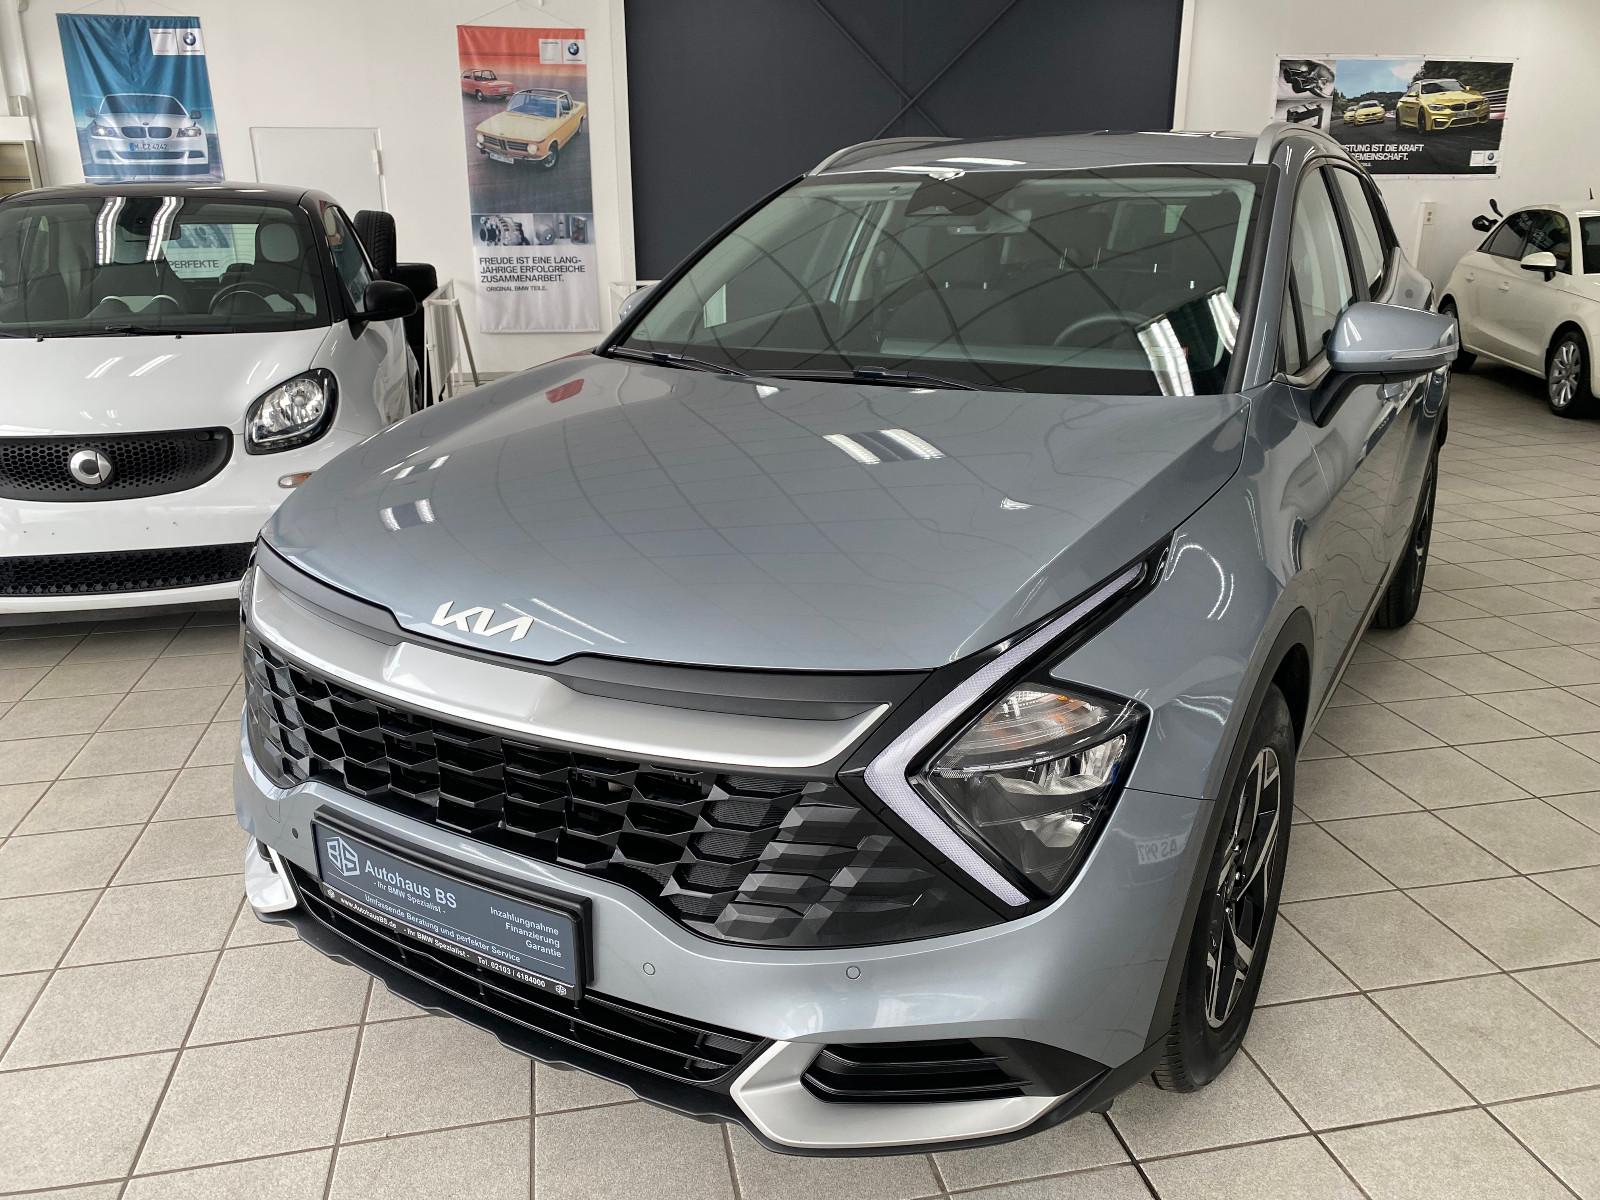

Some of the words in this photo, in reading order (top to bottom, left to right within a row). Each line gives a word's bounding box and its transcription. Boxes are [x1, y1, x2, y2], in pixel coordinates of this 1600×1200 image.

[1344, 144, 1370, 152] STUNG
[1371, 144, 1384, 152] IST
[1385, 144, 1398, 152] DIE
[1398, 144, 1424, 152] KRAFT
[168, 259, 220, 269] PERFEKTE
[479, 256, 514, 265] FREUDE
[516, 256, 530, 265] IST
[532, 256, 551, 265] EINE
[553, 255, 582, 264] LANG-
[520, 264, 586, 274] ERFOLGREICHE
[480, 274, 565, 283] ZUSAMMENARBEIT.
[431, 600, 535, 642] KIA
[364, 860, 431, 899] Autohaus
[434, 887, 457, 909] BS
[377, 881, 387, 891] Ihr
[387, 885, 406, 899] BMW
[407, 894, 442, 913] Spezialist
[340, 897, 397, 929] www.AutohausBS.de
[490, 906, 559, 936] Inzahlungnahme
[364, 893, 405, 918] Umfassende
[406, 912, 439, 933] Beratung
[440, 927, 455, 938] und
[456, 933, 490, 951] perfekter
[491, 946, 521, 963] Service
[505, 922, 560, 948] Finanzierung
[407, 928, 416, 937] Ihr
[416, 931, 434, 944] BMW
[434, 939, 466, 958] Spezialist
[525, 940, 562, 958] Garantie
[477, 956, 490, 967] Tel.
[490, 961, 511, 975] 02103
